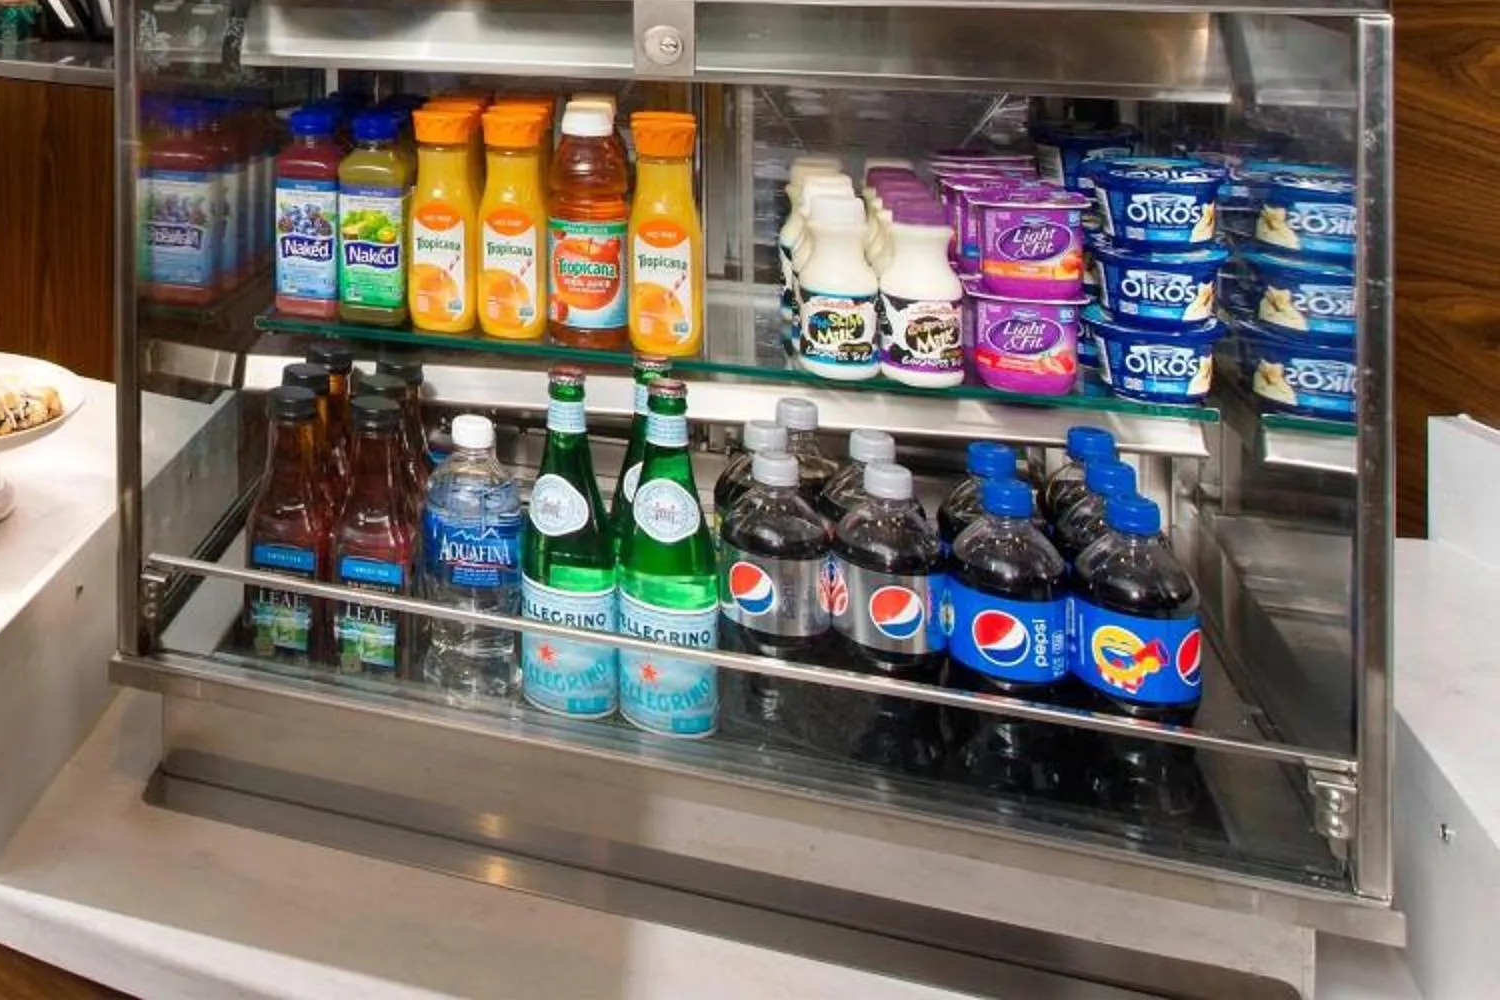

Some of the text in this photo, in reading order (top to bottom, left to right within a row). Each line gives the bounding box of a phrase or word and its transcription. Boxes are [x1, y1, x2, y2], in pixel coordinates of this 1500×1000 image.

[416, 237, 460, 252] Tropicana
[1013, 228, 1056, 248] Light
[285, 239, 329, 258] Naked
[349, 245, 395, 265] Naked
[486, 241, 533, 257] Tropicana
[558, 258, 616, 277] Tropicana
[638, 254, 687, 272] Tropicana
[1003, 322, 1046, 341] Light
[440, 533, 512, 565] AQUAFINA
[1032, 619, 1049, 667] pepsi
